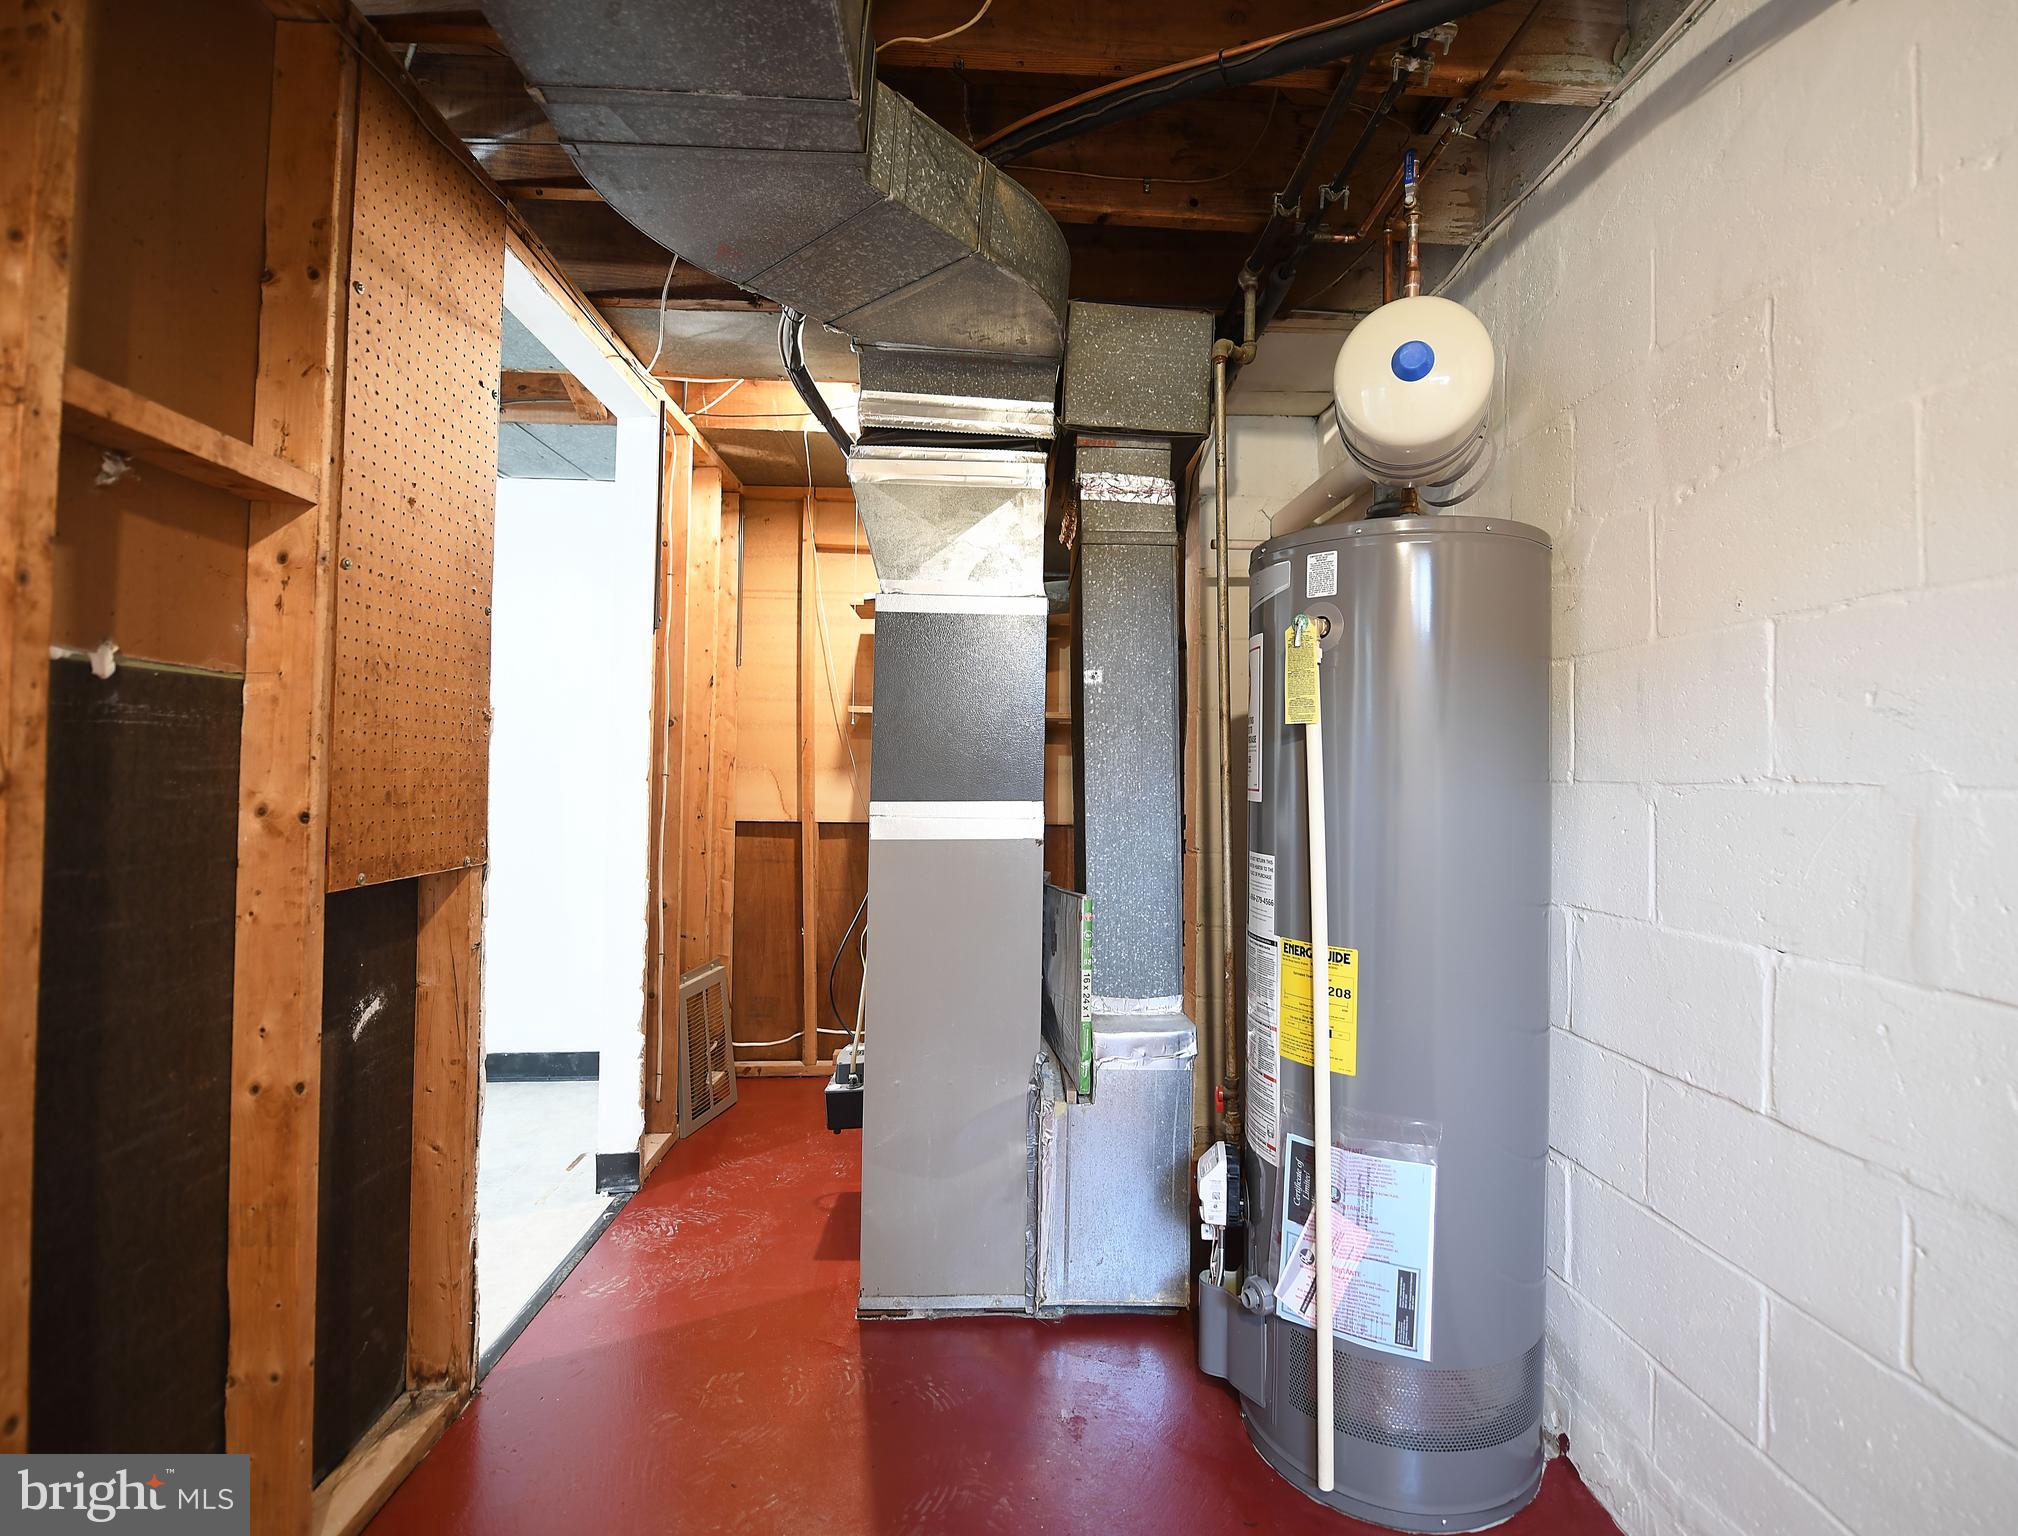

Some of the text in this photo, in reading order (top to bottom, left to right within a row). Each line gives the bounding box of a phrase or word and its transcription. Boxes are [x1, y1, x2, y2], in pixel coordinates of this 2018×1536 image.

[1083, 973, 1091, 983] 16
[1083, 993, 1091, 1004] 24
[1293, 1157, 1304, 1206] Certificate of
[1302, 1169, 1311, 1200] Limited
